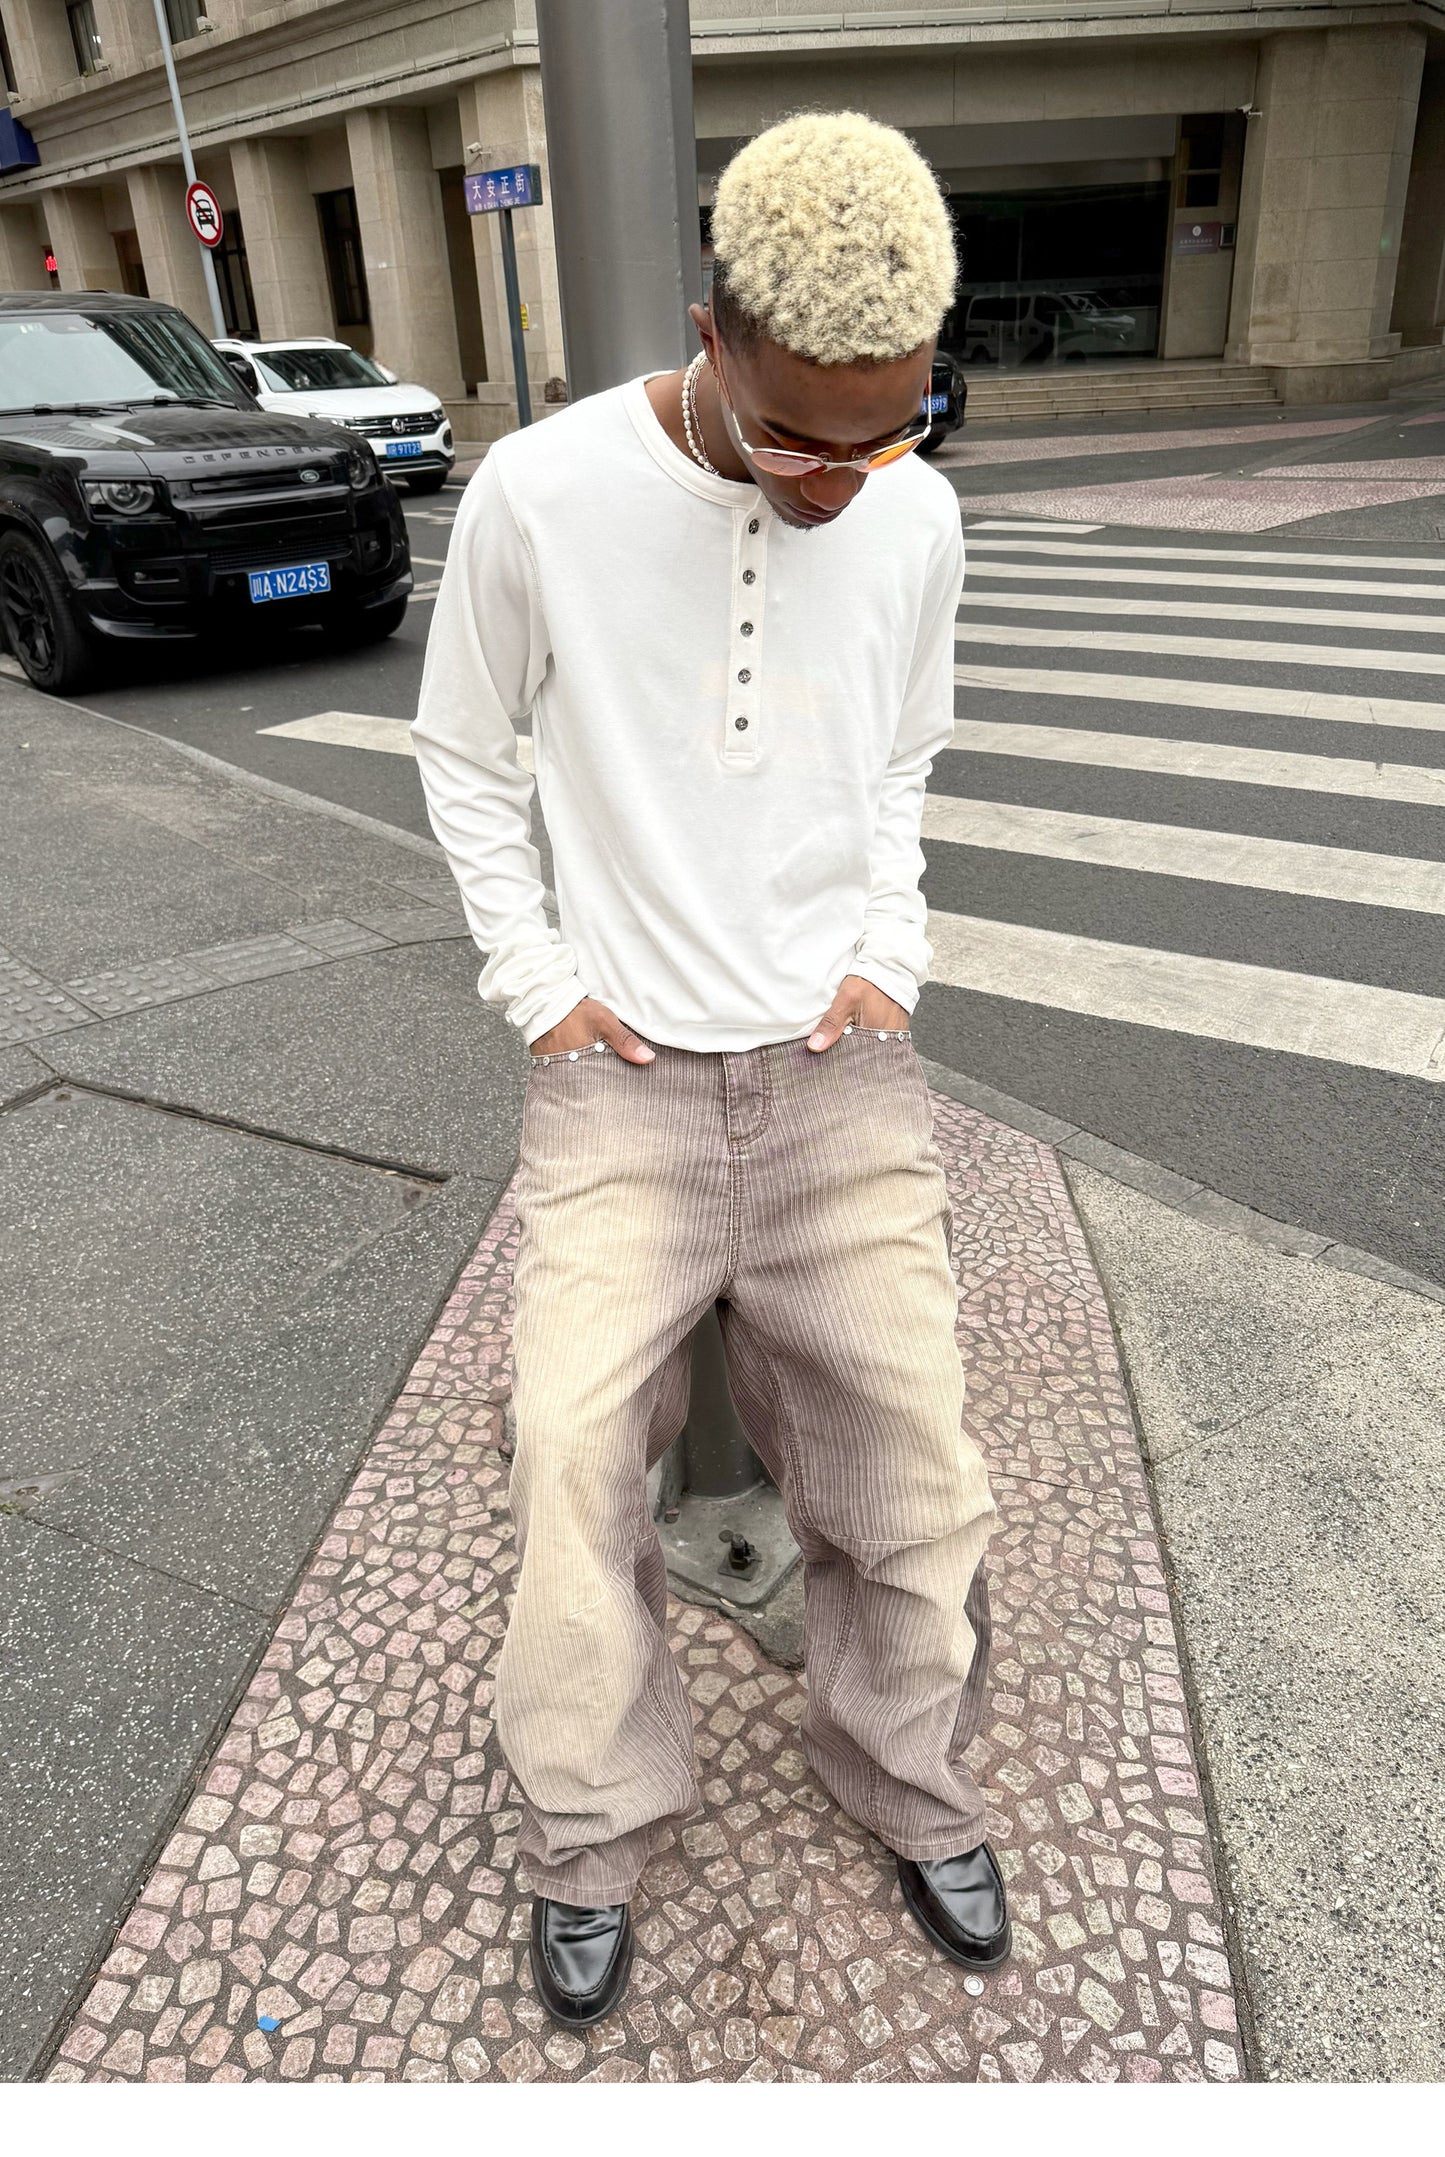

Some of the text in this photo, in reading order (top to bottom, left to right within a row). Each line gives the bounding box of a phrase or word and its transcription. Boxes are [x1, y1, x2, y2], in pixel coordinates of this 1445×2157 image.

[472, 173, 525, 200] 大安正街
[183, 446, 321, 464] DEFENDER
